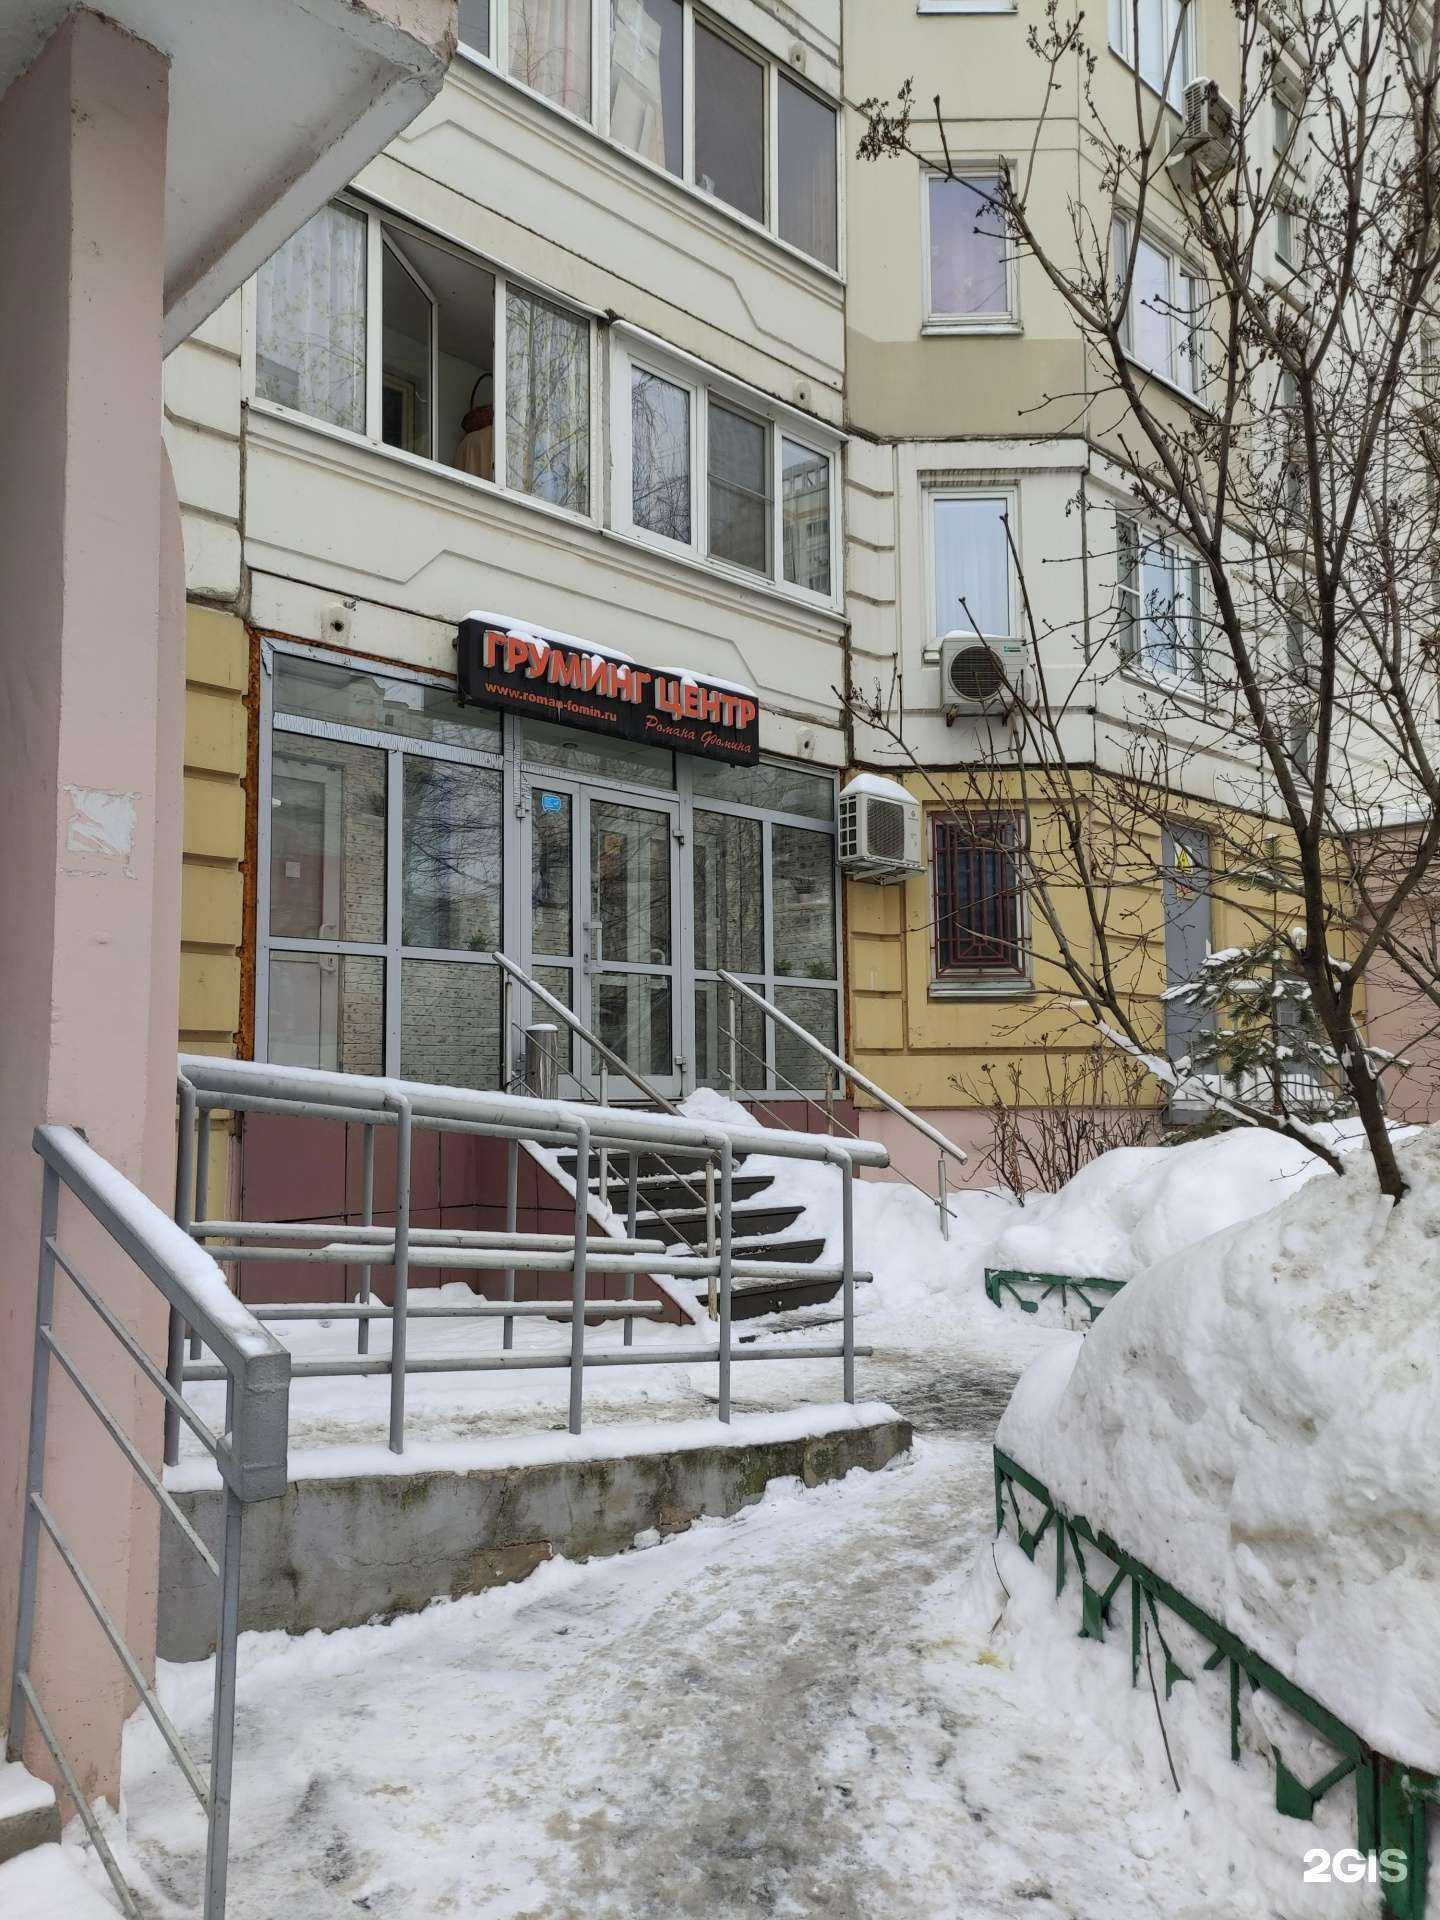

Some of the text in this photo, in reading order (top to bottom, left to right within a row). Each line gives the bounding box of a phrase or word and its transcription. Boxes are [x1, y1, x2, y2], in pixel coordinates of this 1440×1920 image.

[483, 630, 756, 730] ГРУМИНГ ЦЕНТР
[485, 681, 617, 722] www.roman-fomin.ru
[645, 714, 753, 753] Романа Фомина
